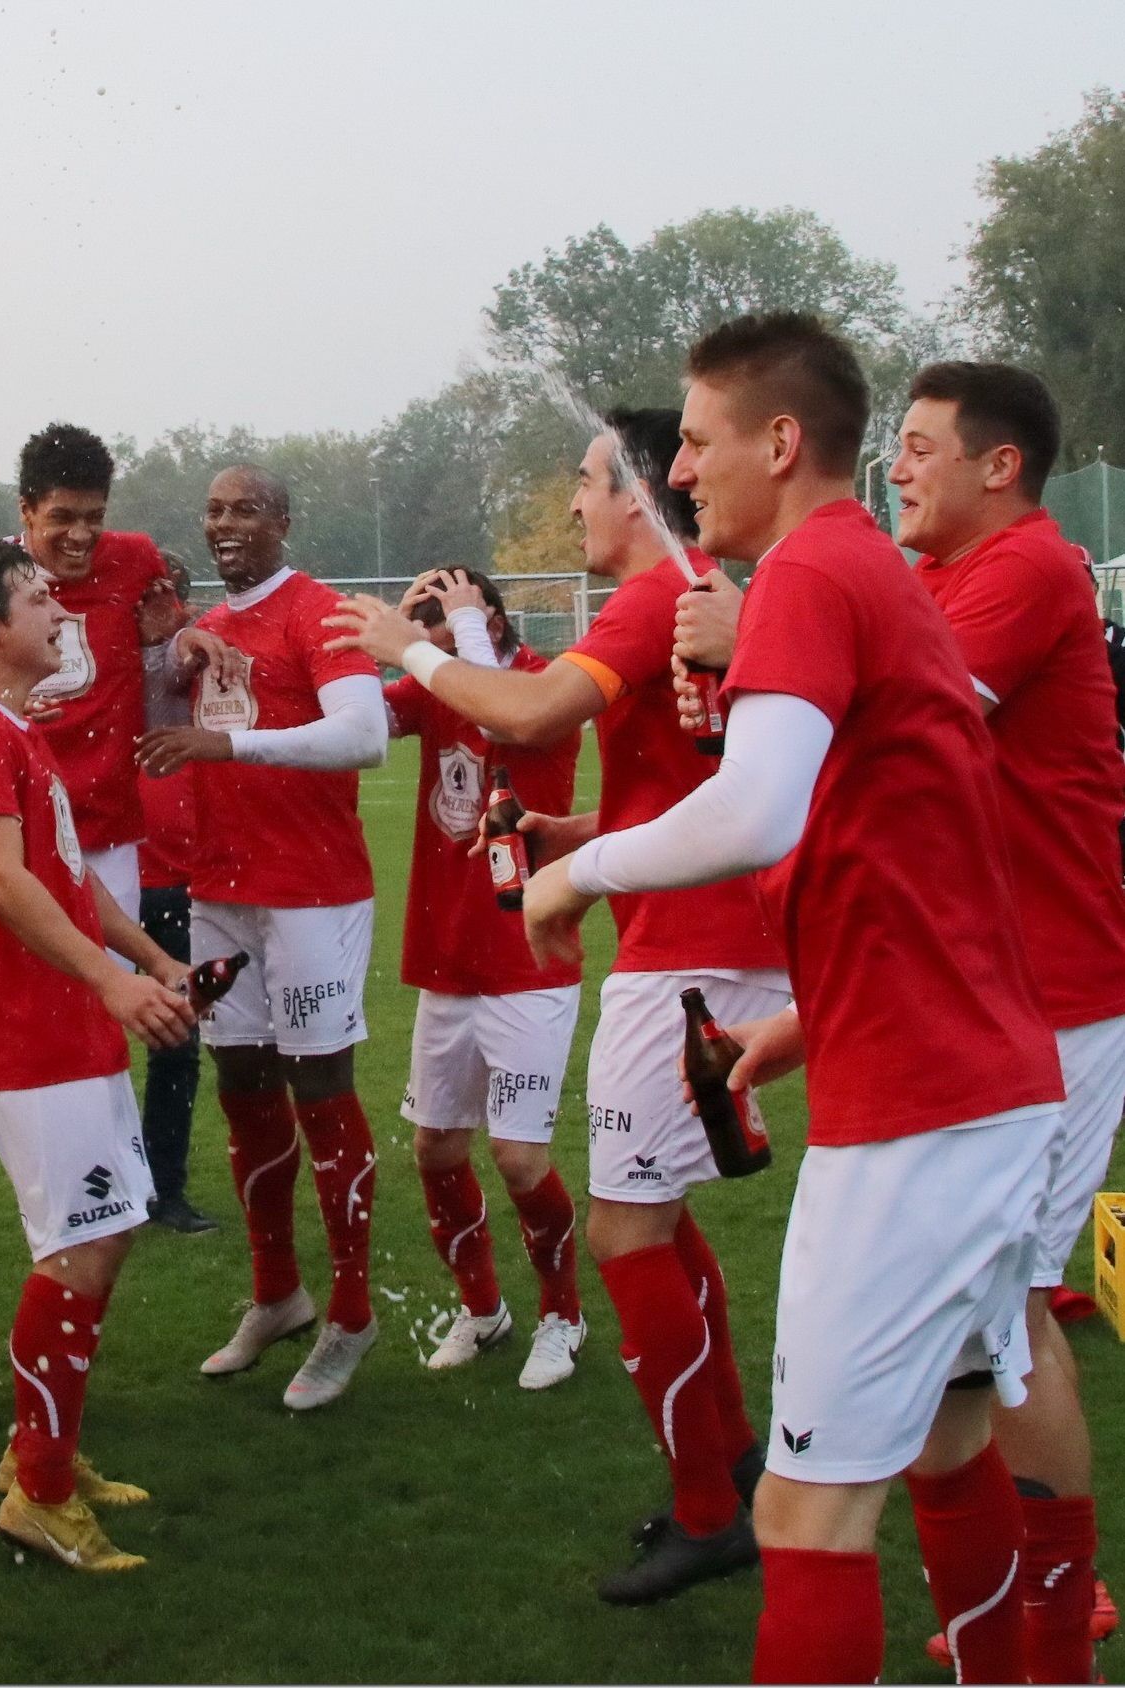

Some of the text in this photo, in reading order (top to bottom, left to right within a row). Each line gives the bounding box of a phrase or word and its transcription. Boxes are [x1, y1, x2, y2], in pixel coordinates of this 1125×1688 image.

[282, 979, 346, 1002] SAEGEN
[491, 1072, 551, 1092] AEGEN
[627, 1170, 662, 1181] erima
